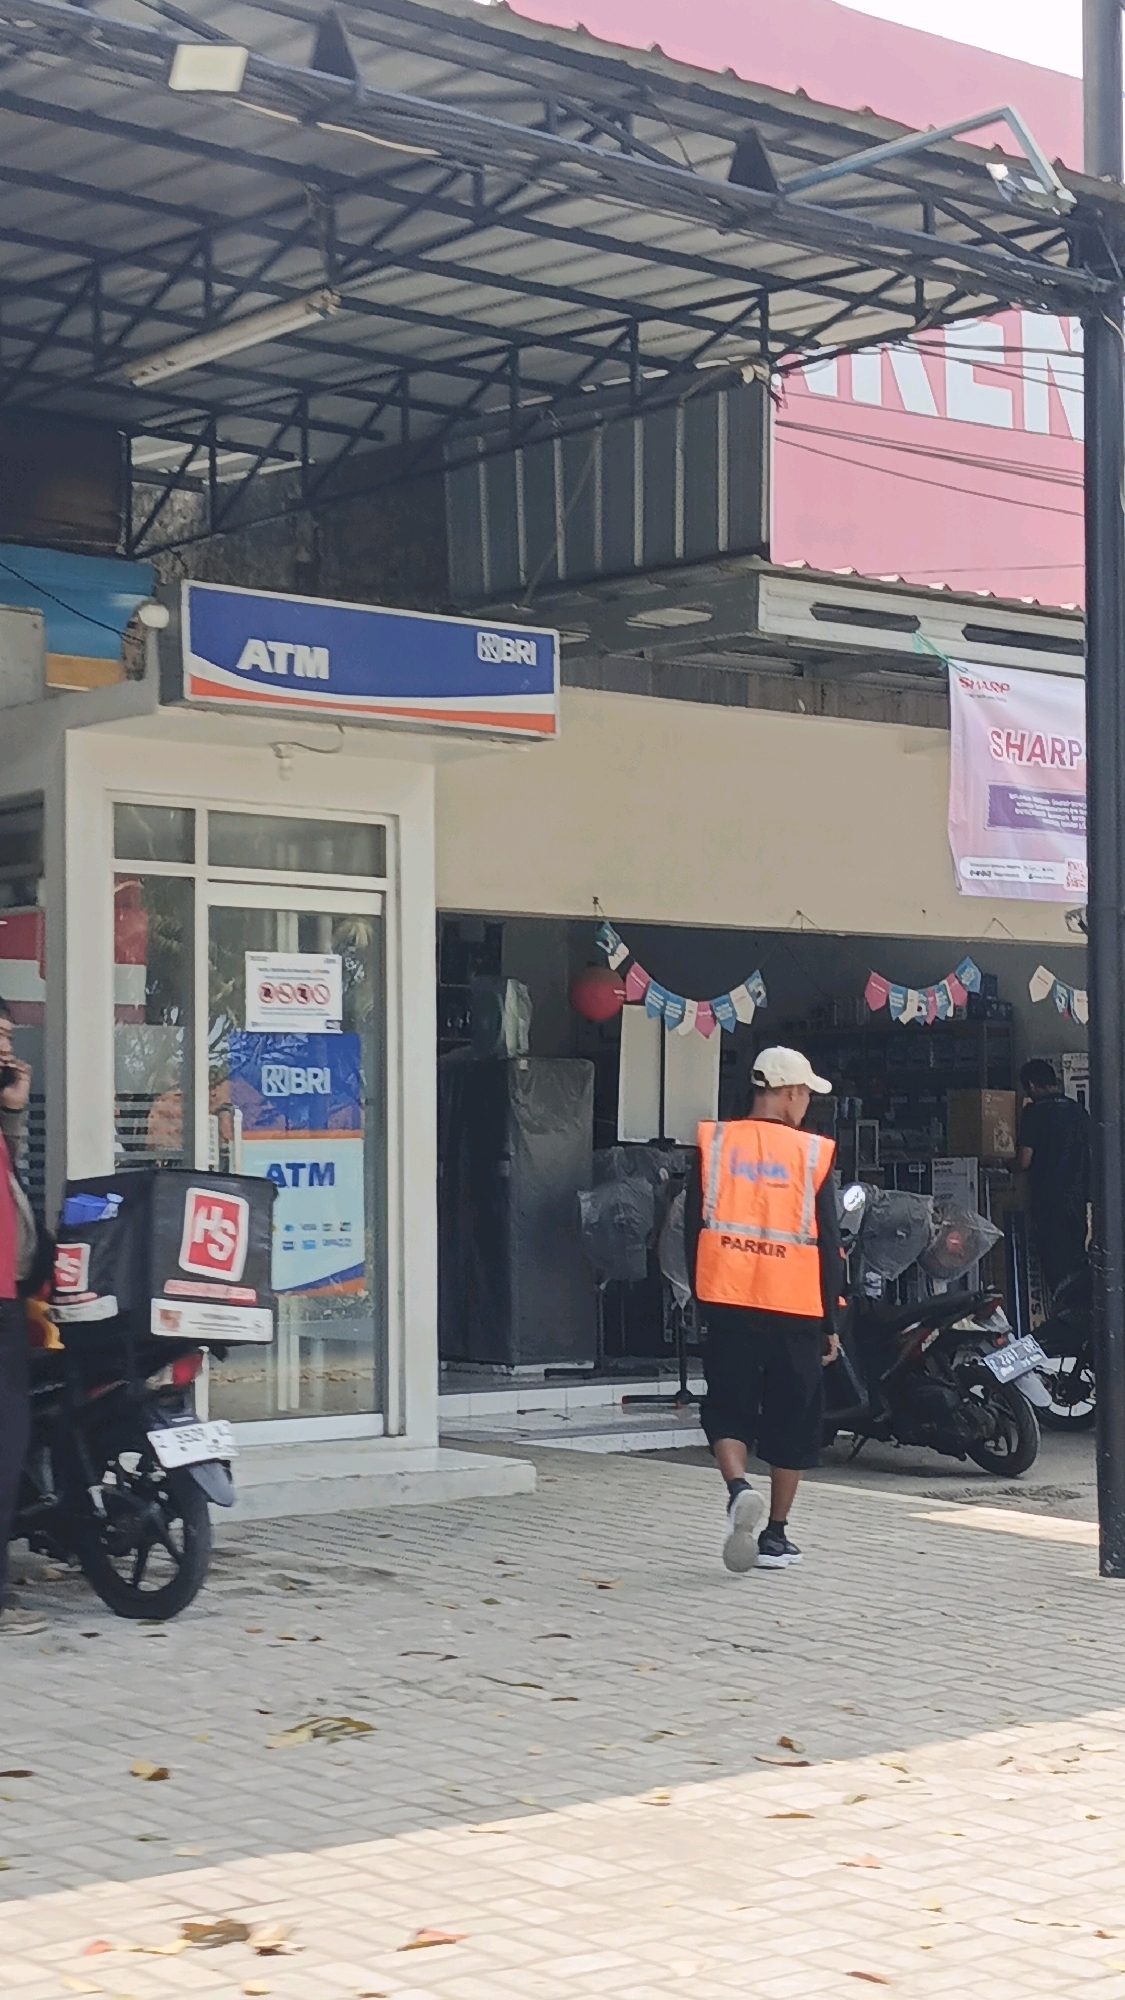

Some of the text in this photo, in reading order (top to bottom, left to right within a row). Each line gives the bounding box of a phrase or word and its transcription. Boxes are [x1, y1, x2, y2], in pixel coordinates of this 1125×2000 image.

[236, 638, 329, 680] ATM
[502, 637, 537, 666] BRI
[959, 677, 1010, 693] SHARP
[990, 729, 1082, 768] SHARP
[290, 1067, 331, 1095] BRI
[267, 1162, 335, 1188] ATM
[721, 1235, 787, 1259] PARKIR
